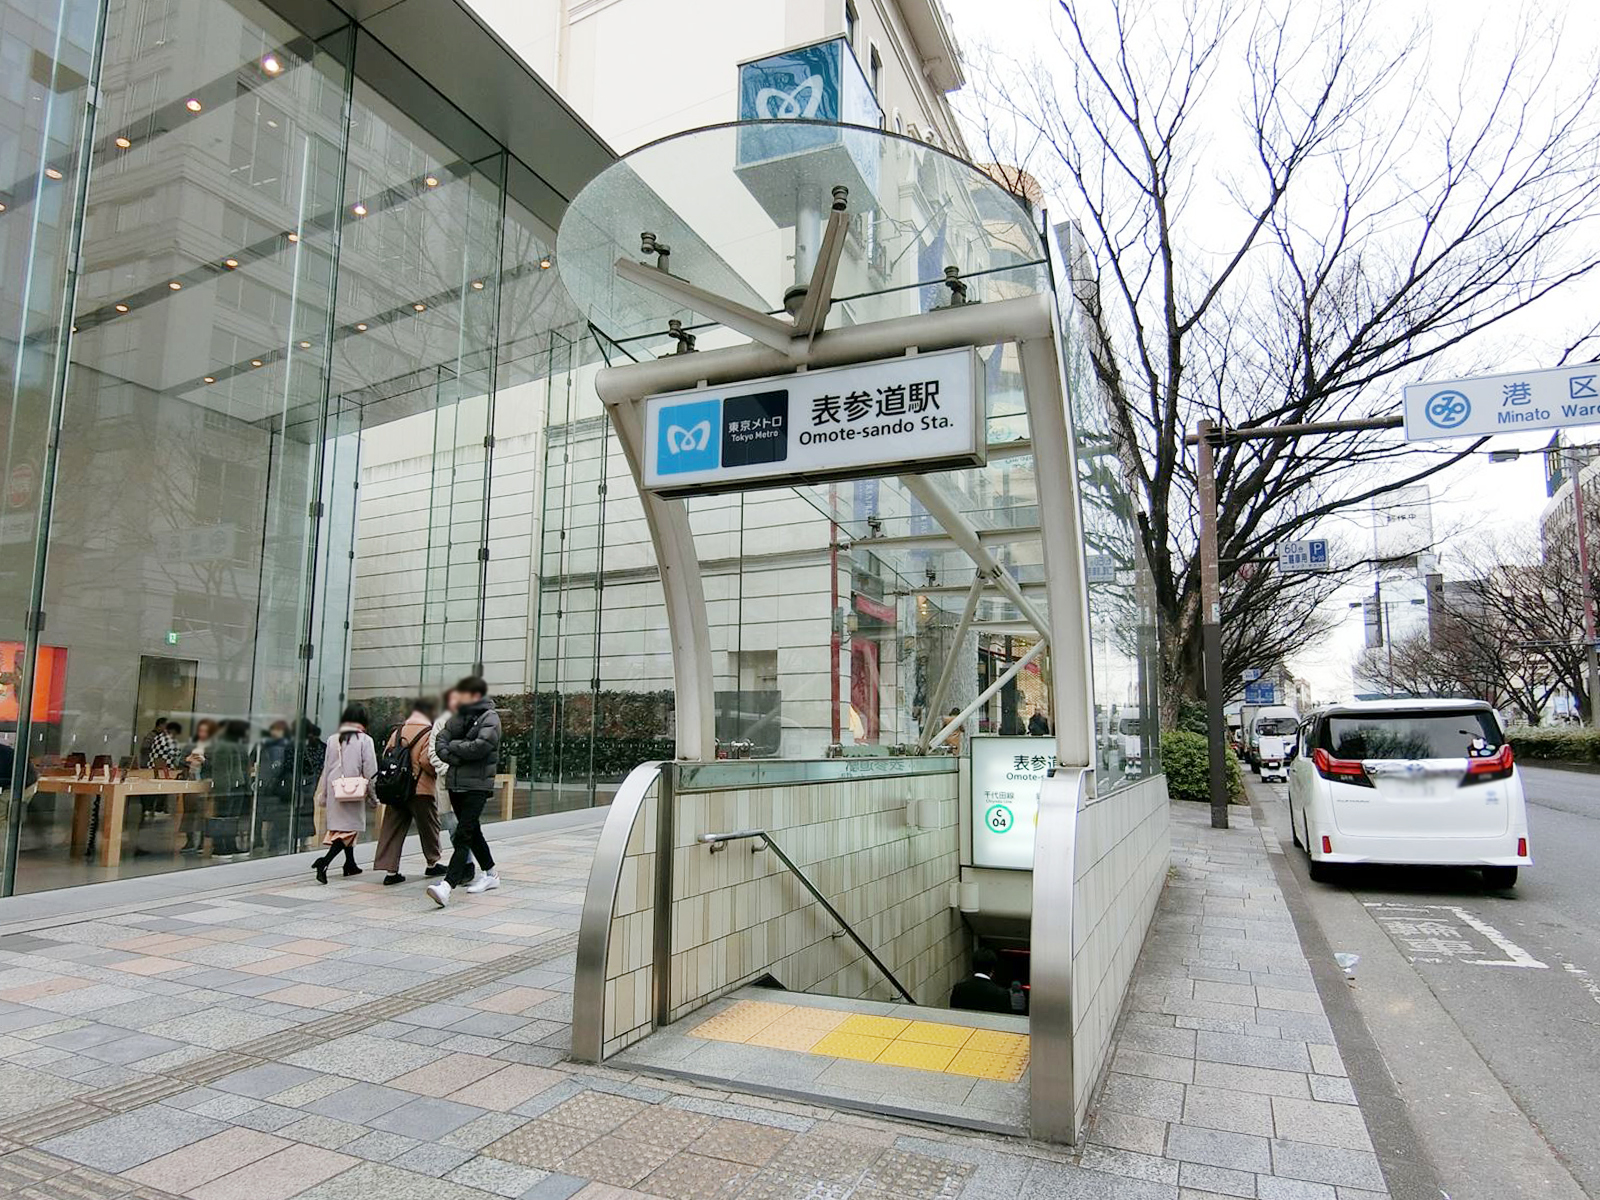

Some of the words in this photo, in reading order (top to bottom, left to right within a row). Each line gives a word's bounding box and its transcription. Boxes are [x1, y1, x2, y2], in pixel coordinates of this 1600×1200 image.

[811, 380, 941, 427] 表参道駅
[1497, 408, 1550, 424] Minato
[728, 415, 782, 434] 東京メトロ
[799, 421, 915, 446] Omote-sando
[920, 414, 954, 431] Sta.
[730, 432, 754, 442] Tokyo
[754, 429, 779, 440] Metro
[1313, 542, 1323, 555] P
[984, 790, 1015, 800] 千代田線
[996, 809, 1002, 817] C
[992, 818, 1006, 827] 04
